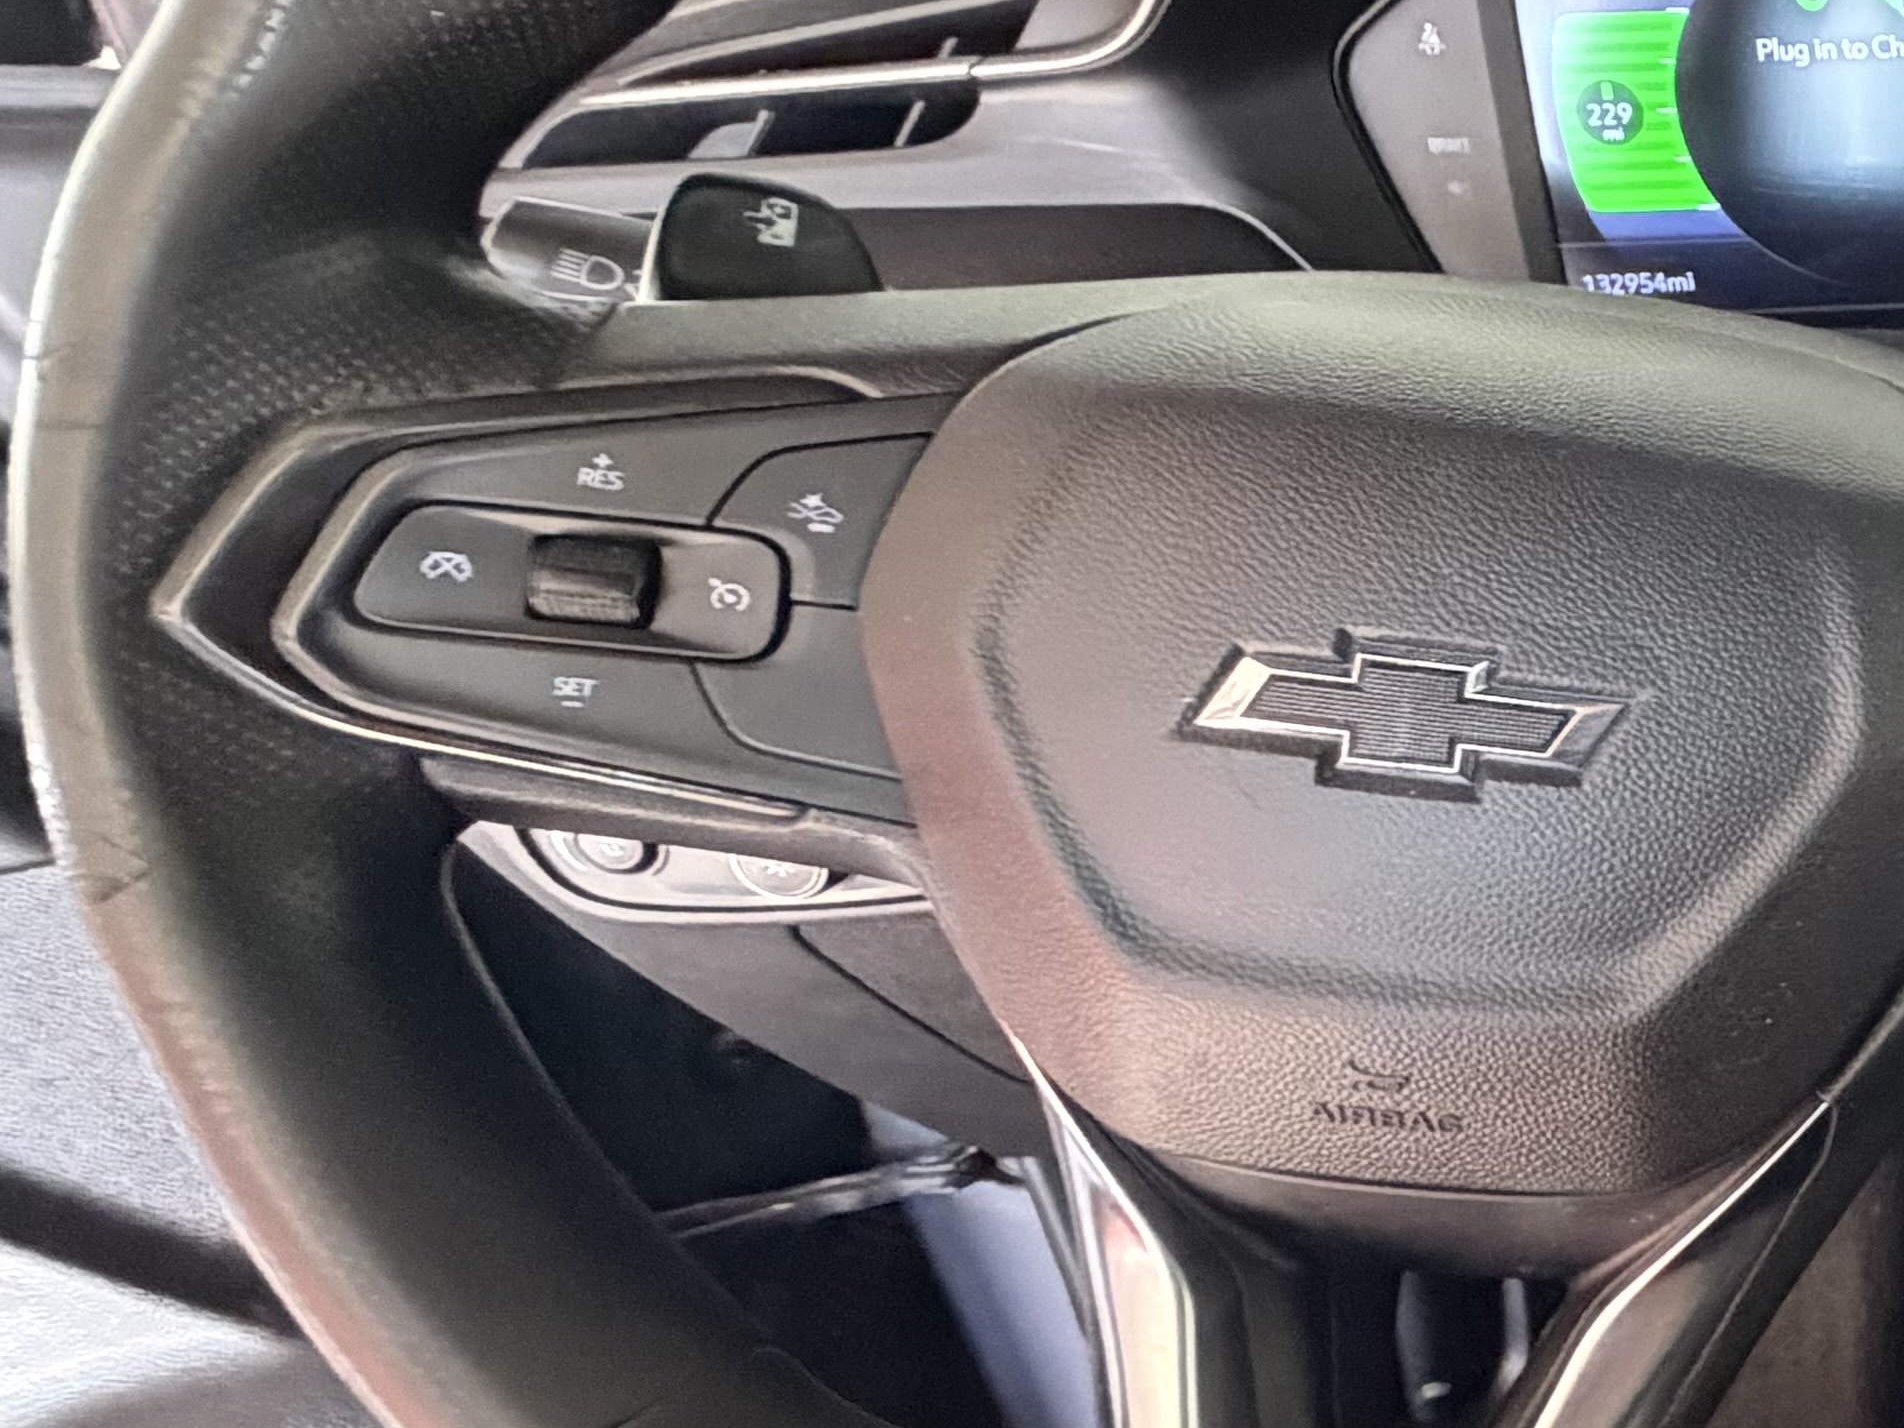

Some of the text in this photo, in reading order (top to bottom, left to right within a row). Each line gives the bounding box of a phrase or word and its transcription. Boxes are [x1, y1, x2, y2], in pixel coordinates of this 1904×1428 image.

[1756, 37, 1811, 67] Plug
[1813, 38, 1838, 60] in
[1841, 38, 1869, 60] to
[1586, 102, 1633, 127] 229
[1602, 127, 1625, 141] mi
[577, 467, 625, 490] RES
[553, 677, 599, 697] SET
[1312, 1102, 1464, 1133] AIRBAG
